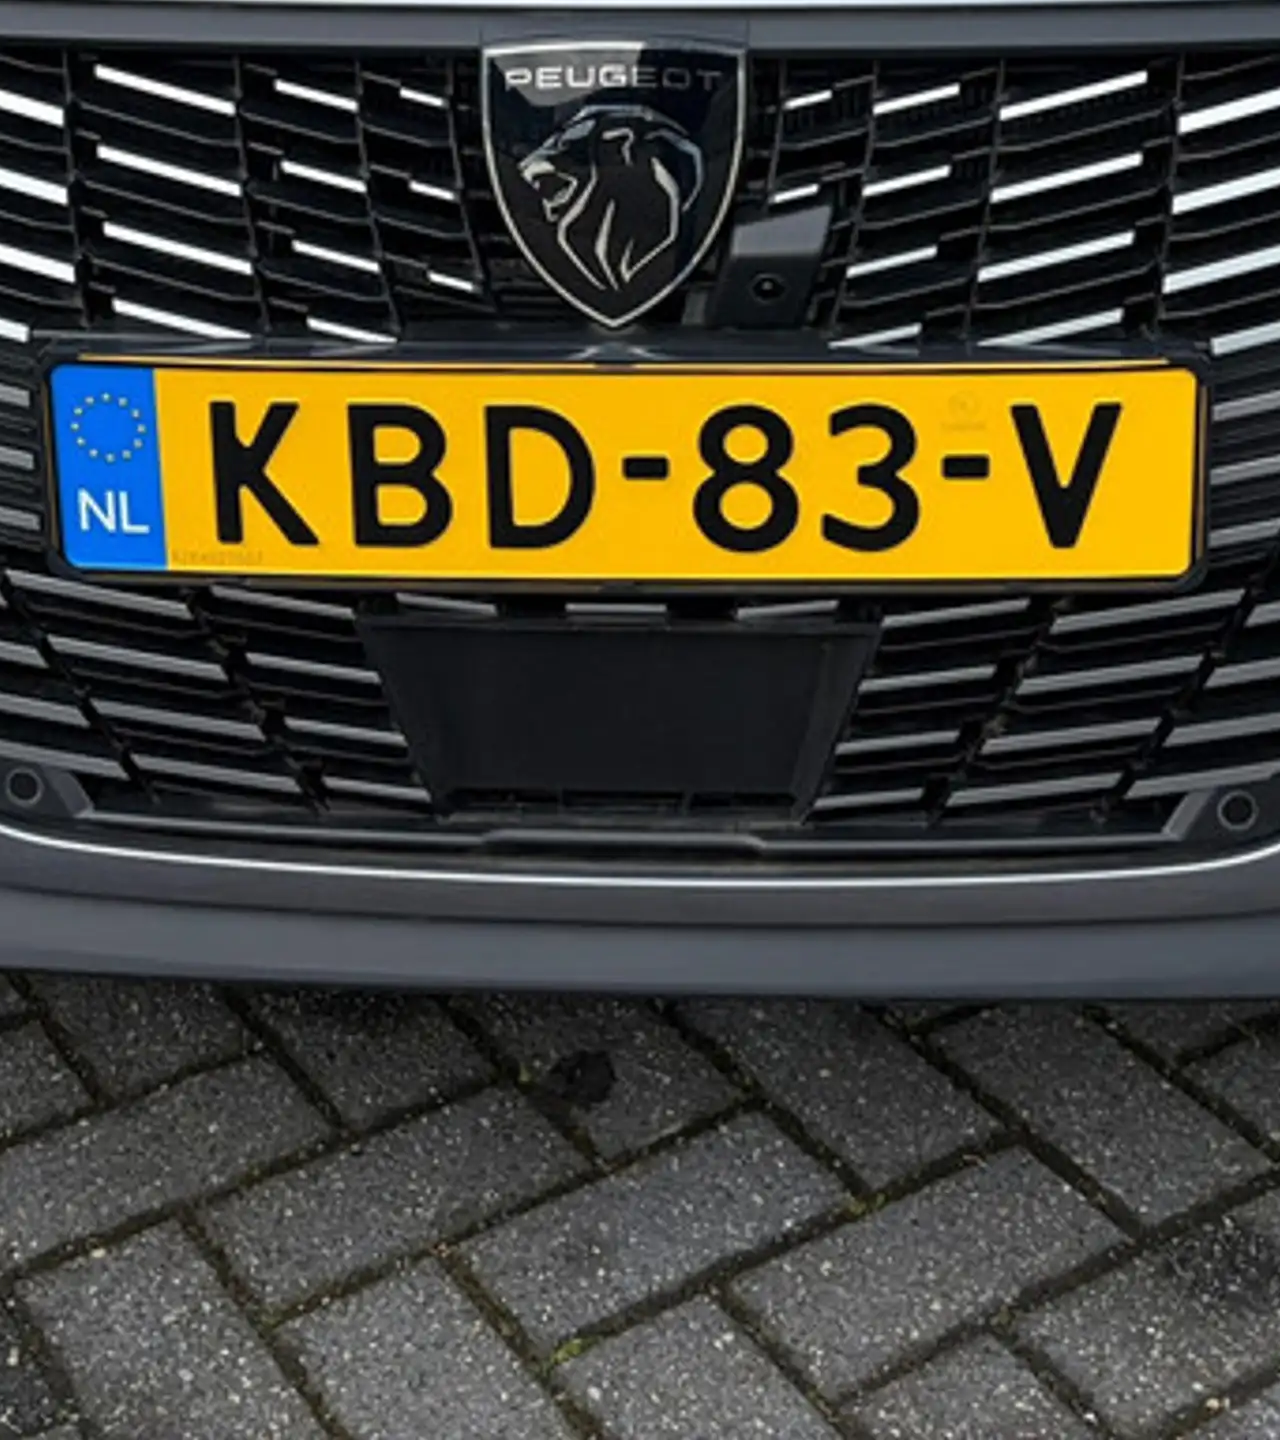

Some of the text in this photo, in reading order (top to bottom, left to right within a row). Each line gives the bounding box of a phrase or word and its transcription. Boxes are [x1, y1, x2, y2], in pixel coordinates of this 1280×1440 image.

[504, 63, 722, 90] PEUGEOT
[78, 400, 1123, 553] NL KBD-83-V
